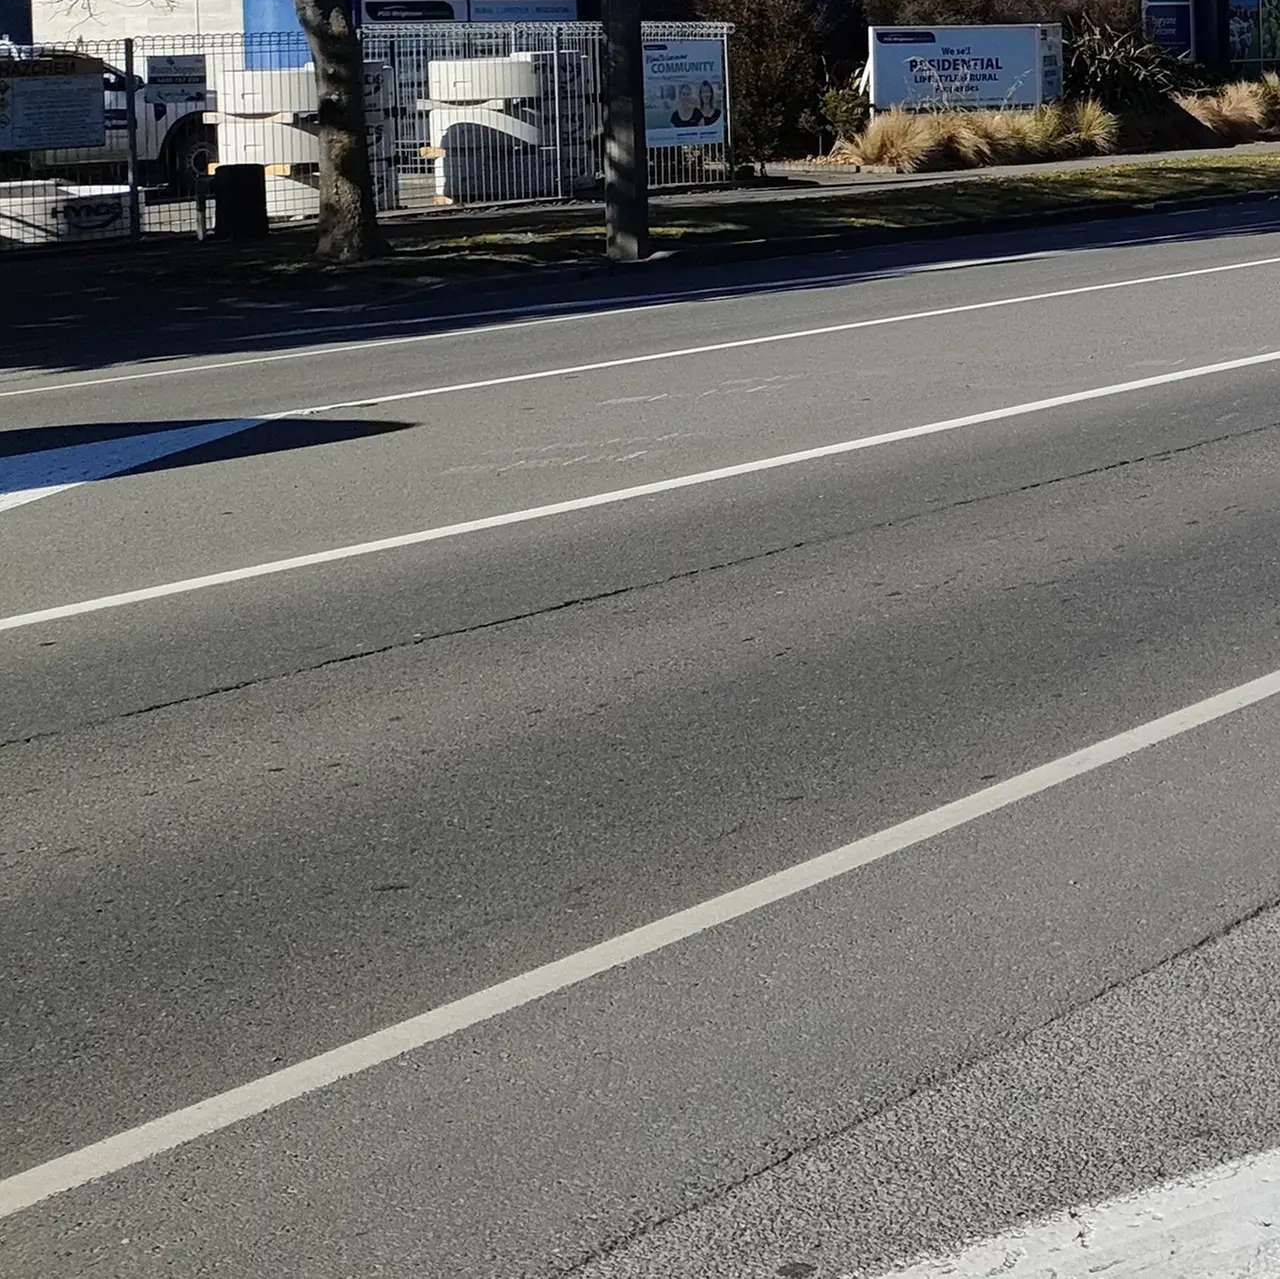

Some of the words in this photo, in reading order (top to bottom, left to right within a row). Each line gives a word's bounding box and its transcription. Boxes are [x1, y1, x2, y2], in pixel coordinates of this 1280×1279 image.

[941, 47, 955, 55] We
[651, 61, 715, 74] COMMUNITY
[910, 58, 1003, 72] RESIDENTIAL
[969, 73, 999, 82] RURAL
